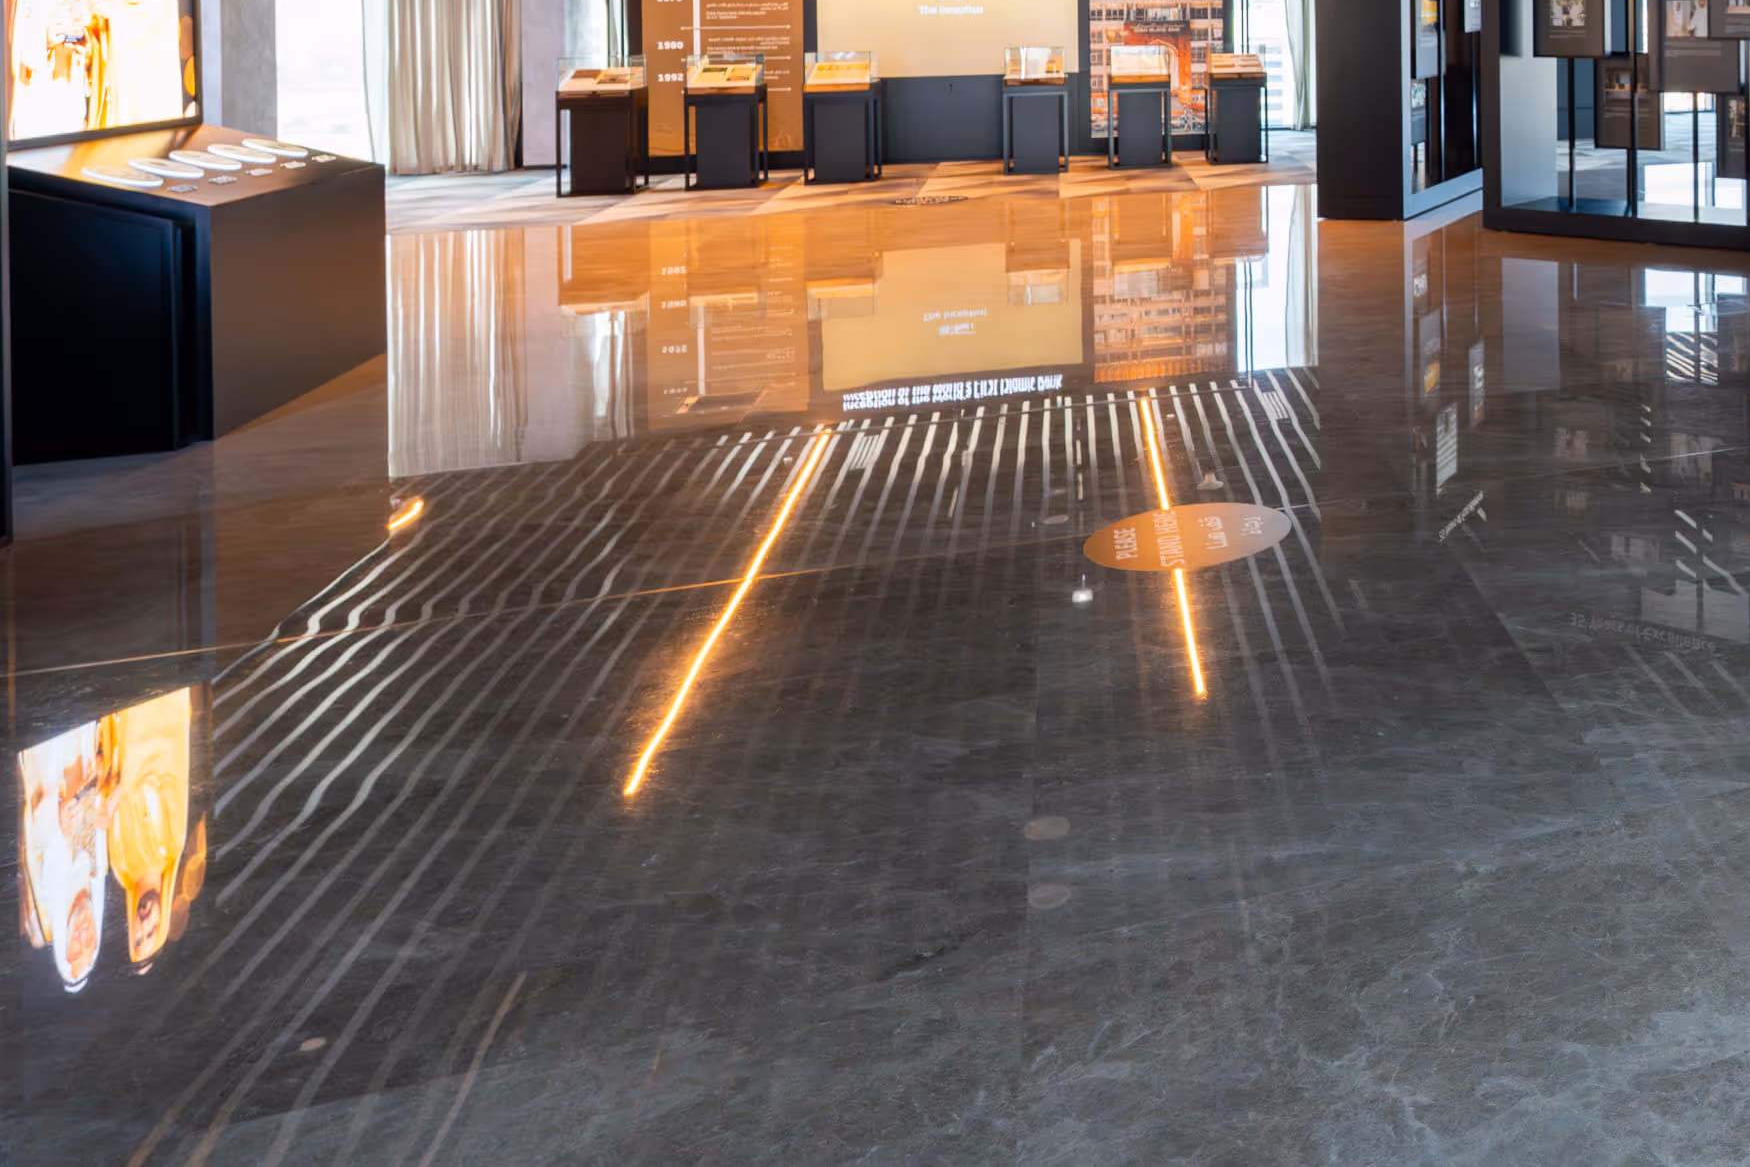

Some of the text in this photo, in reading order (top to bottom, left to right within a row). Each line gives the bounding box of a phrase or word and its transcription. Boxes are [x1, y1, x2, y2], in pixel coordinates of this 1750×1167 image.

[658, 73, 684, 82] 1992
[1113, 527, 1138, 560] PLEASE
[1153, 510, 1185, 567] STAND HERE
